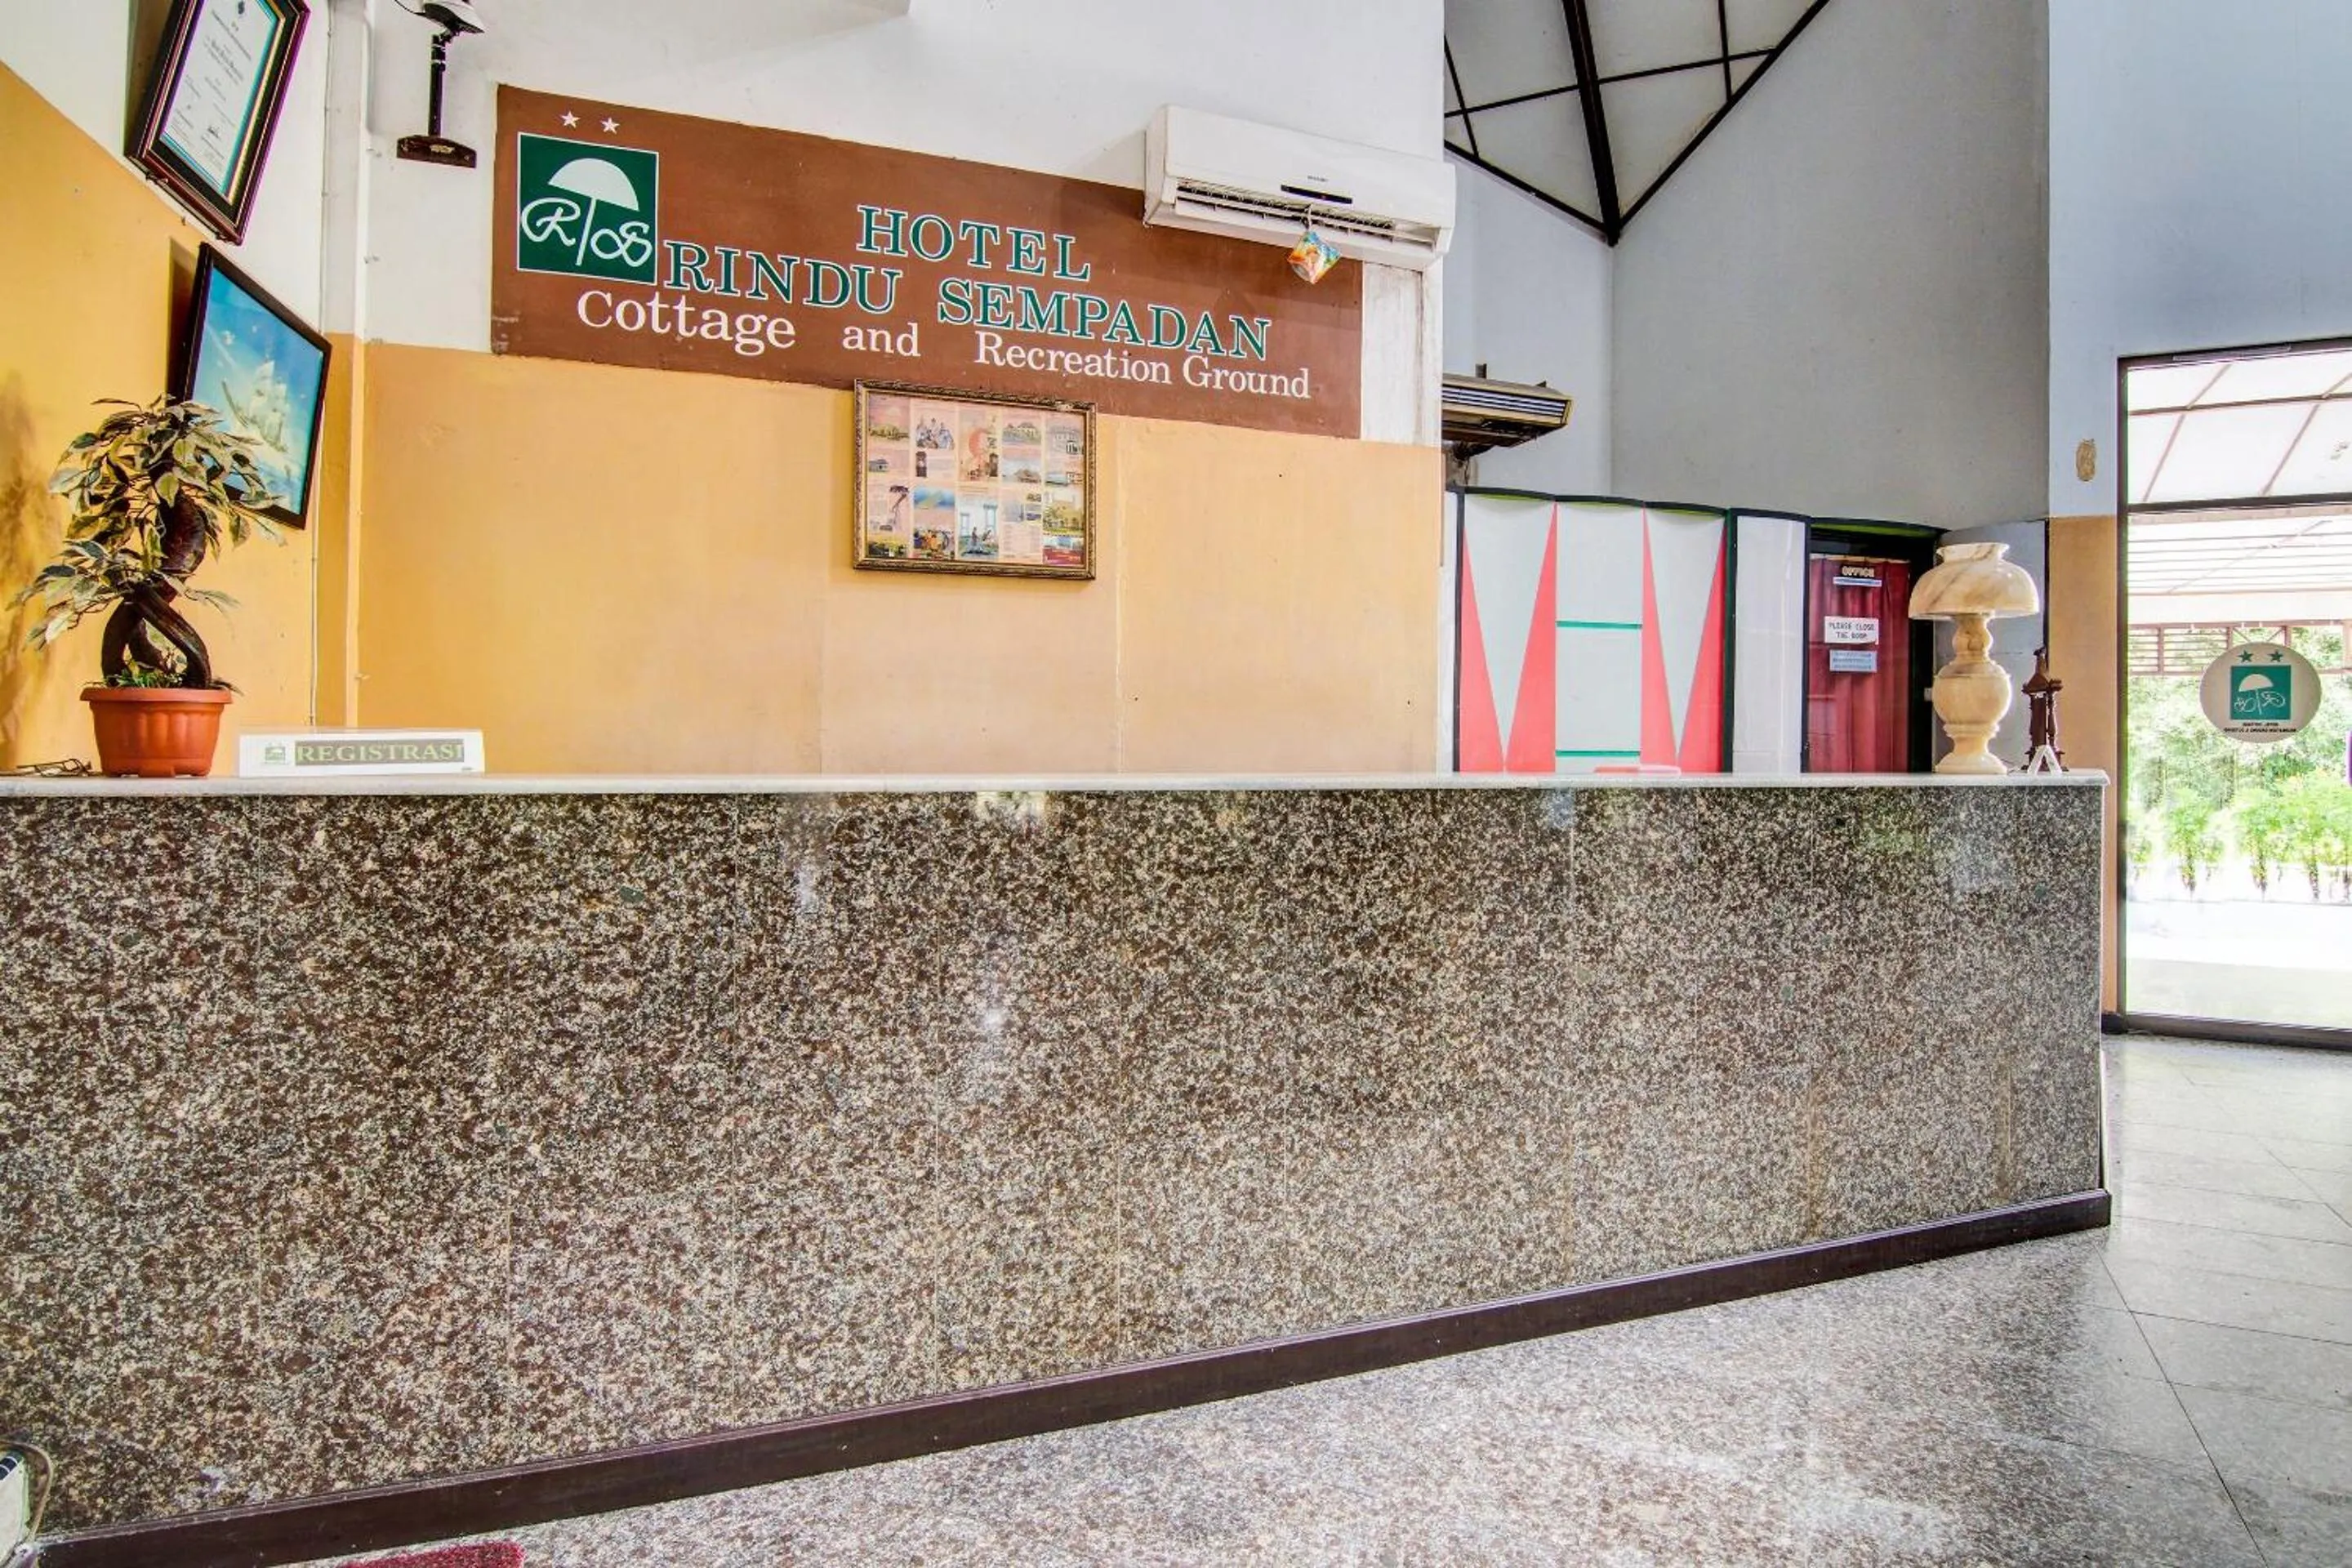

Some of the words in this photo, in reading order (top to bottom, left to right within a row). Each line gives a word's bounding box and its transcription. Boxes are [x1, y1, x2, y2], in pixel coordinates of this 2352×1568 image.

[857, 205, 1090, 282] HOTEL
[577, 290, 796, 356] Cottage
[842, 322, 920, 357] and
[974, 330, 1172, 385] Recreation
[1182, 355, 1311, 399] Ground
[663, 240, 903, 315] RINDU
[938, 276, 1272, 360] SEMPADAN
[296, 743, 463, 763] REGISTRASI
